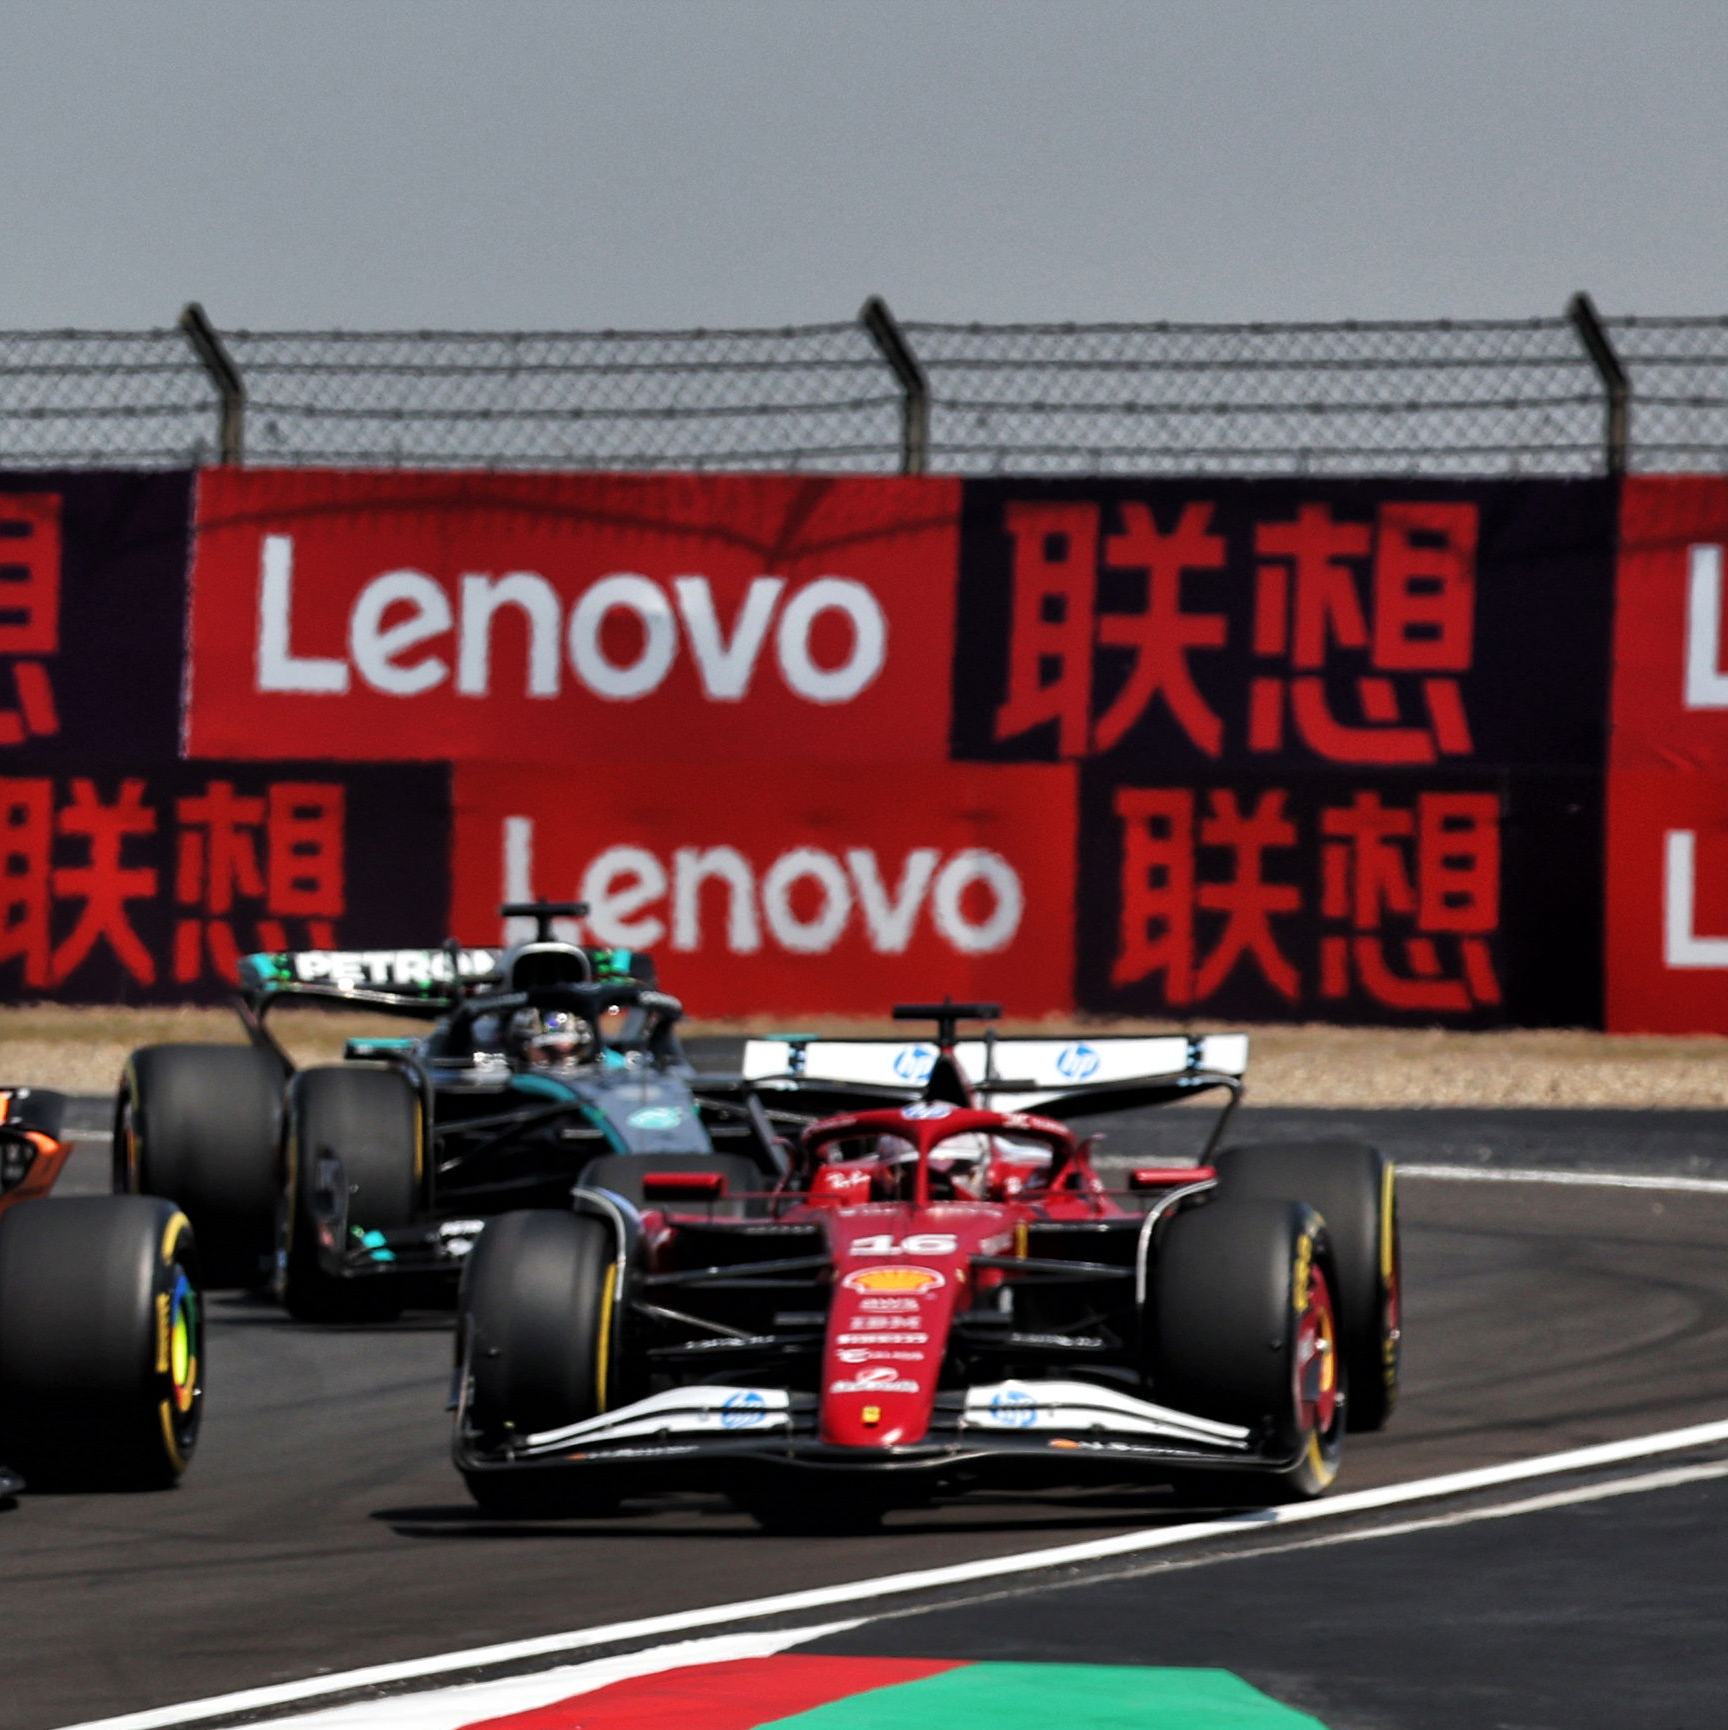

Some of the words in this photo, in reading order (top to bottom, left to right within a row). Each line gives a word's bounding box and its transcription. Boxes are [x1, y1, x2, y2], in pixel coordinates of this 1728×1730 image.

[256, 535, 885, 703] Lenovo
[997, 503, 1479, 762] 联想
[501, 817, 1022, 955] Lenovo
[1113, 788, 1500, 1011] 联想
[850, 1234, 958, 1256] 16
